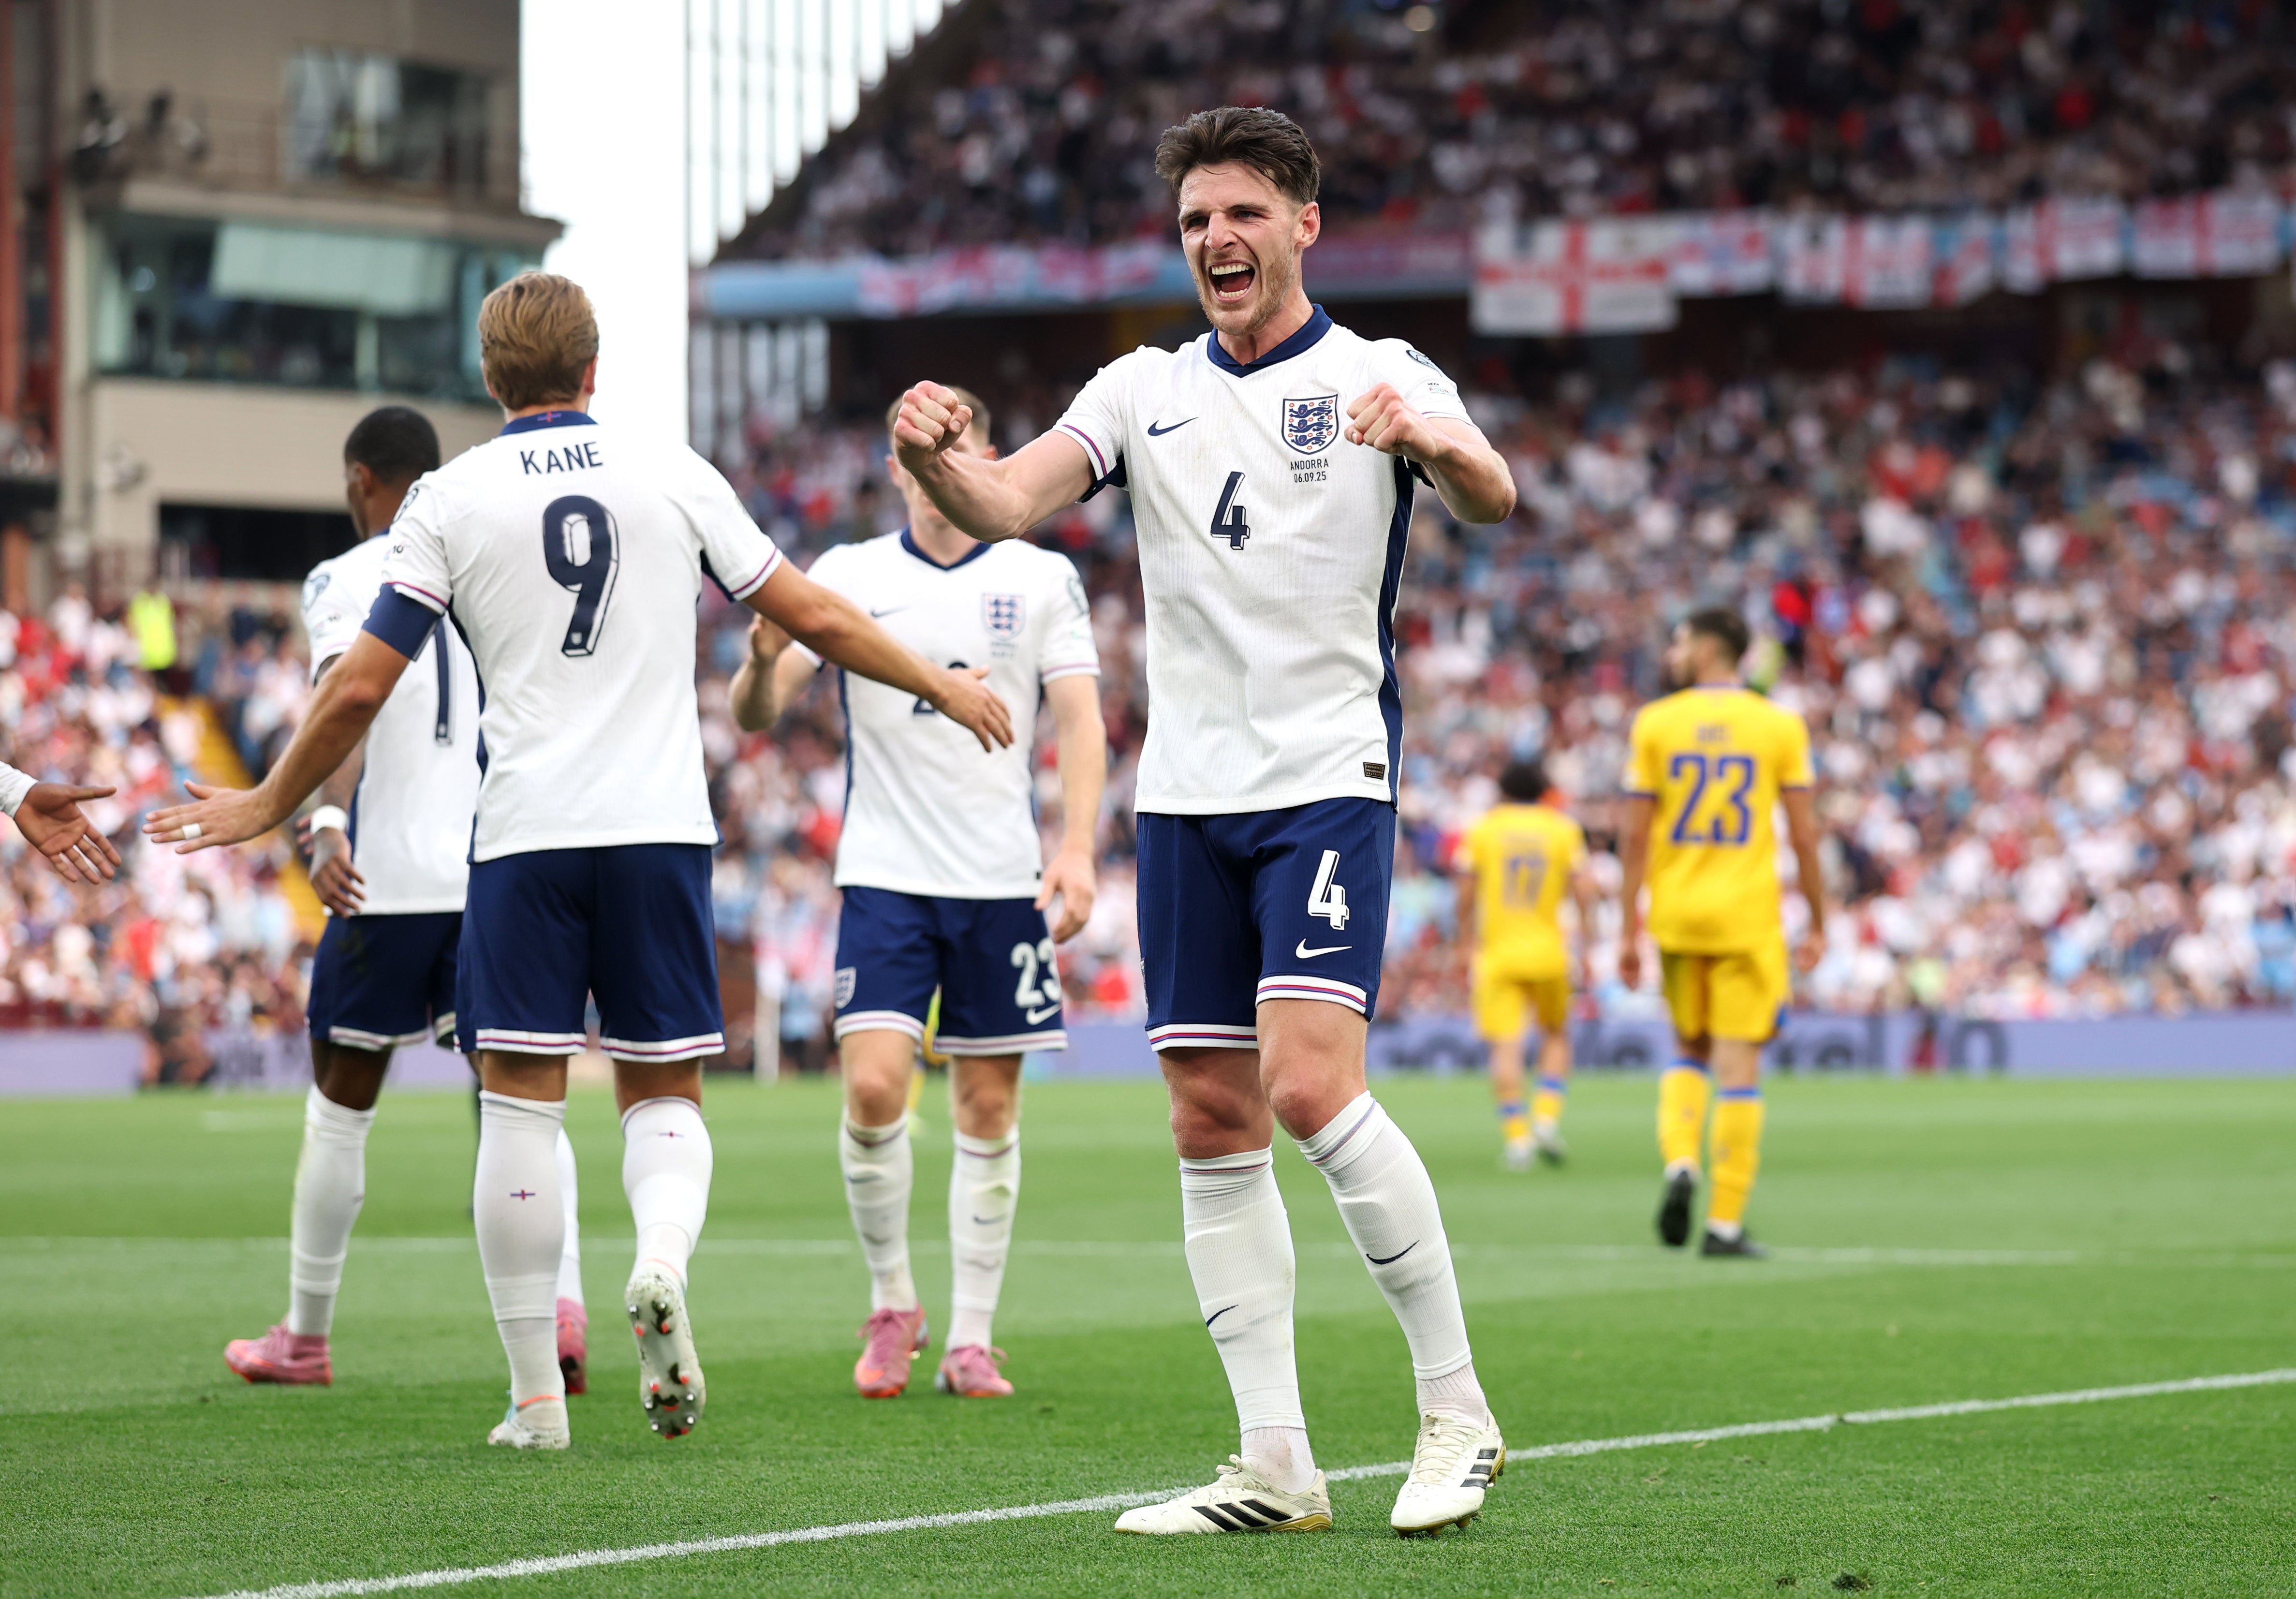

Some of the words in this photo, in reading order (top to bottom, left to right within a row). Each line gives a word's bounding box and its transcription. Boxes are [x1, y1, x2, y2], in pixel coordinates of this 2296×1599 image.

[520, 442, 603, 474] KANE
[1290, 458, 1329, 471] ANDORRA
[1294, 471, 1326, 483] 06.09.25
[1210, 471, 1250, 550] 4
[543, 495, 619, 658] 9
[1670, 754, 1755, 844] 23
[1308, 849, 1349, 931] 4
[1010, 937, 1062, 1008] 23
